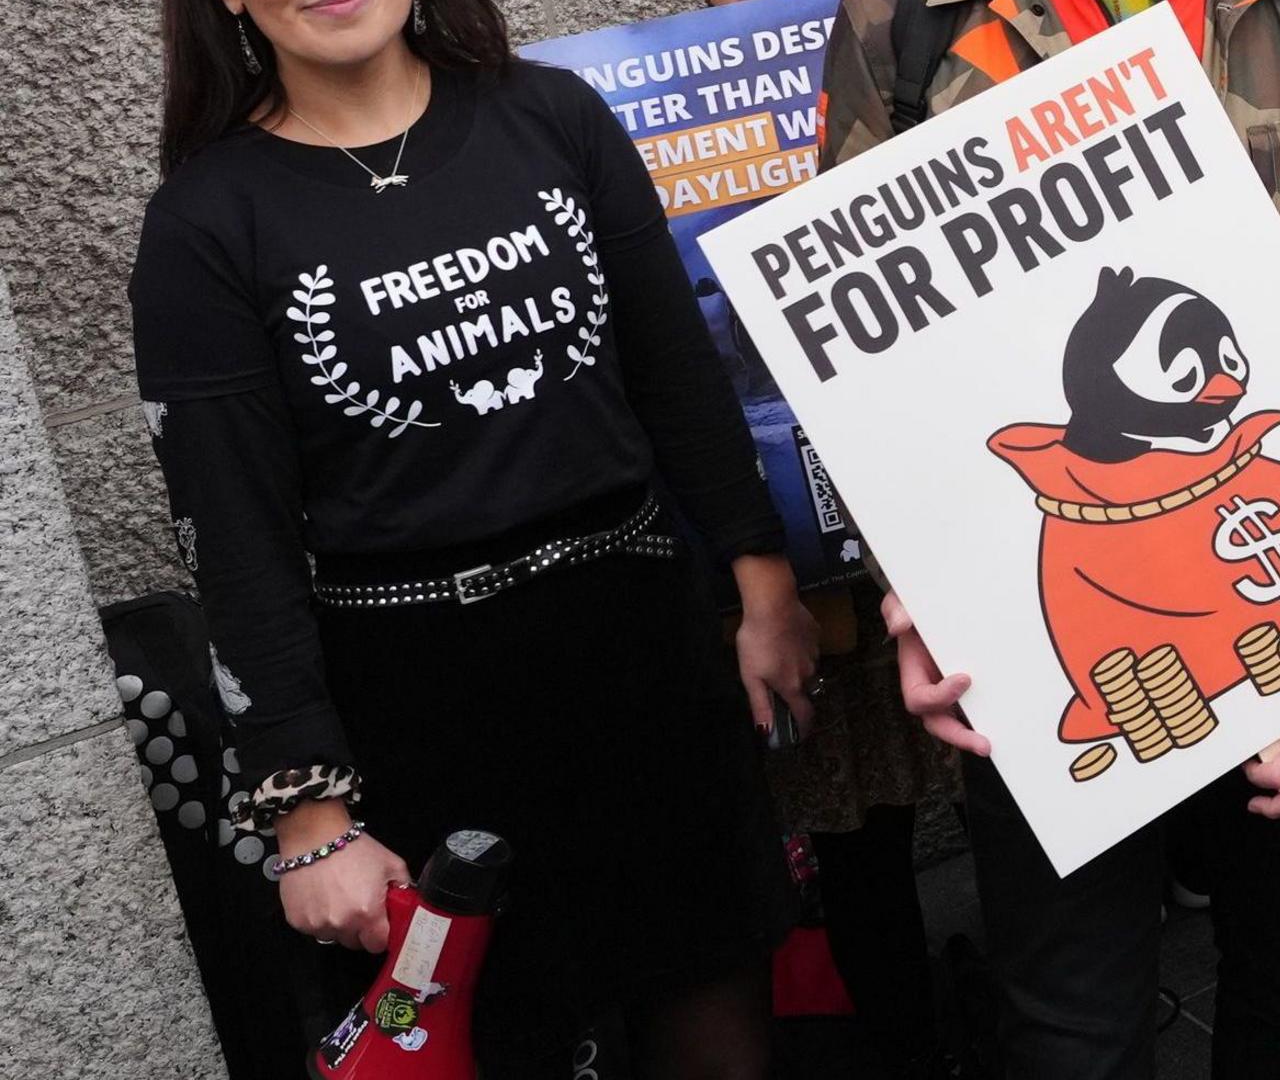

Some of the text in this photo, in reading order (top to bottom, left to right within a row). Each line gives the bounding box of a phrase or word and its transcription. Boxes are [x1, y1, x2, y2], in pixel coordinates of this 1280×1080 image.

[697, 66, 813, 115] THAN
[641, 117, 770, 172] EMENT
[751, 47, 1168, 301] PENGUINS AREN'T
[359, 224, 550, 317] FREEDOM
[782, 102, 1205, 383] FOR PROFIT
[388, 286, 577, 383] ANIMALS
[453, 289, 491, 315] FOR
